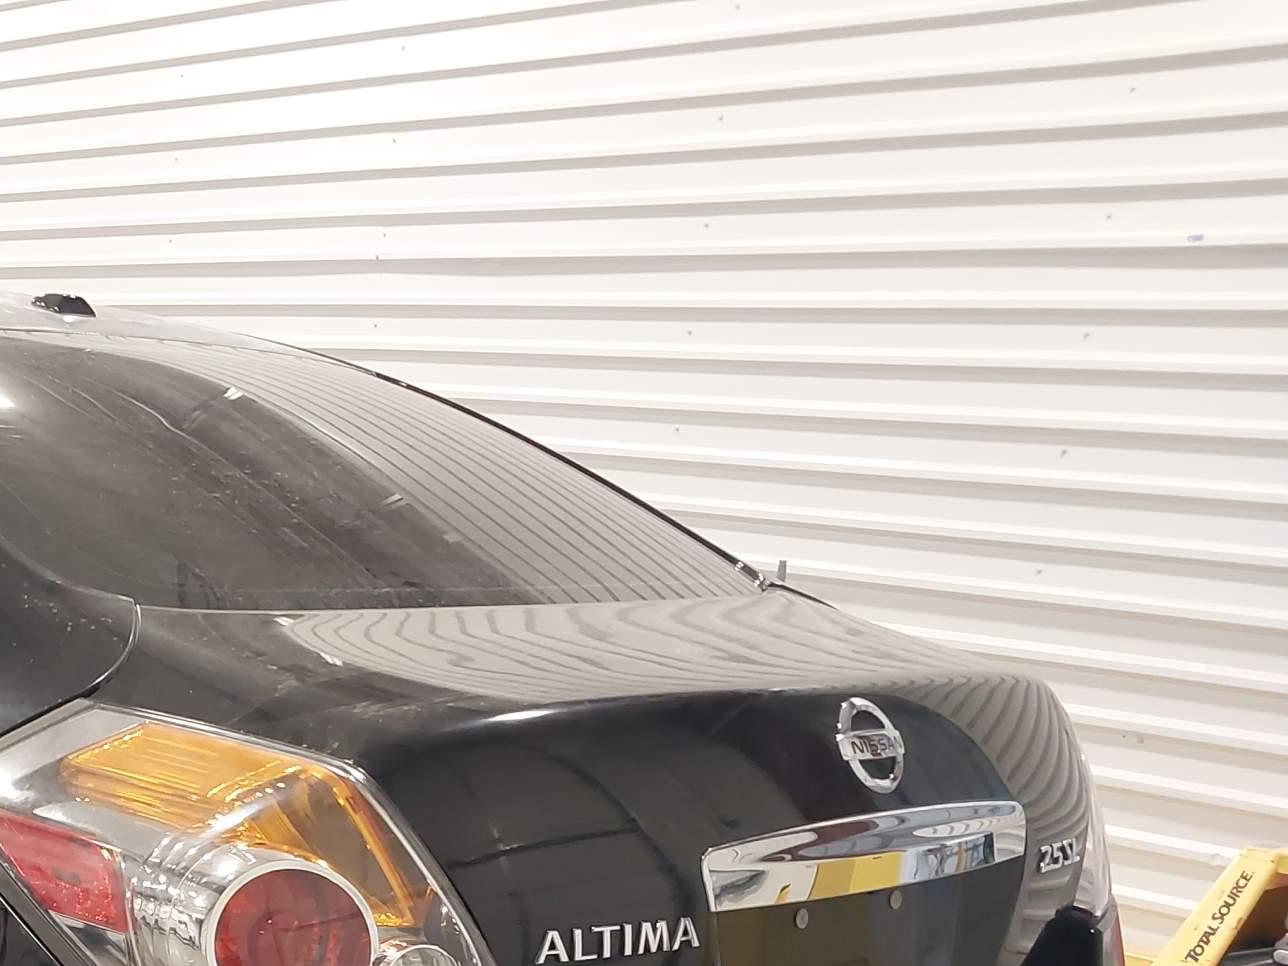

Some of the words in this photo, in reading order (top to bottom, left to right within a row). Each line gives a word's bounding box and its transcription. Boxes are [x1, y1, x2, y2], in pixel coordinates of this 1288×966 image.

[535, 917, 700, 965] ALTIMA
[1184, 925, 1220, 963] TOTAL
[1211, 870, 1254, 925] SOURCE
